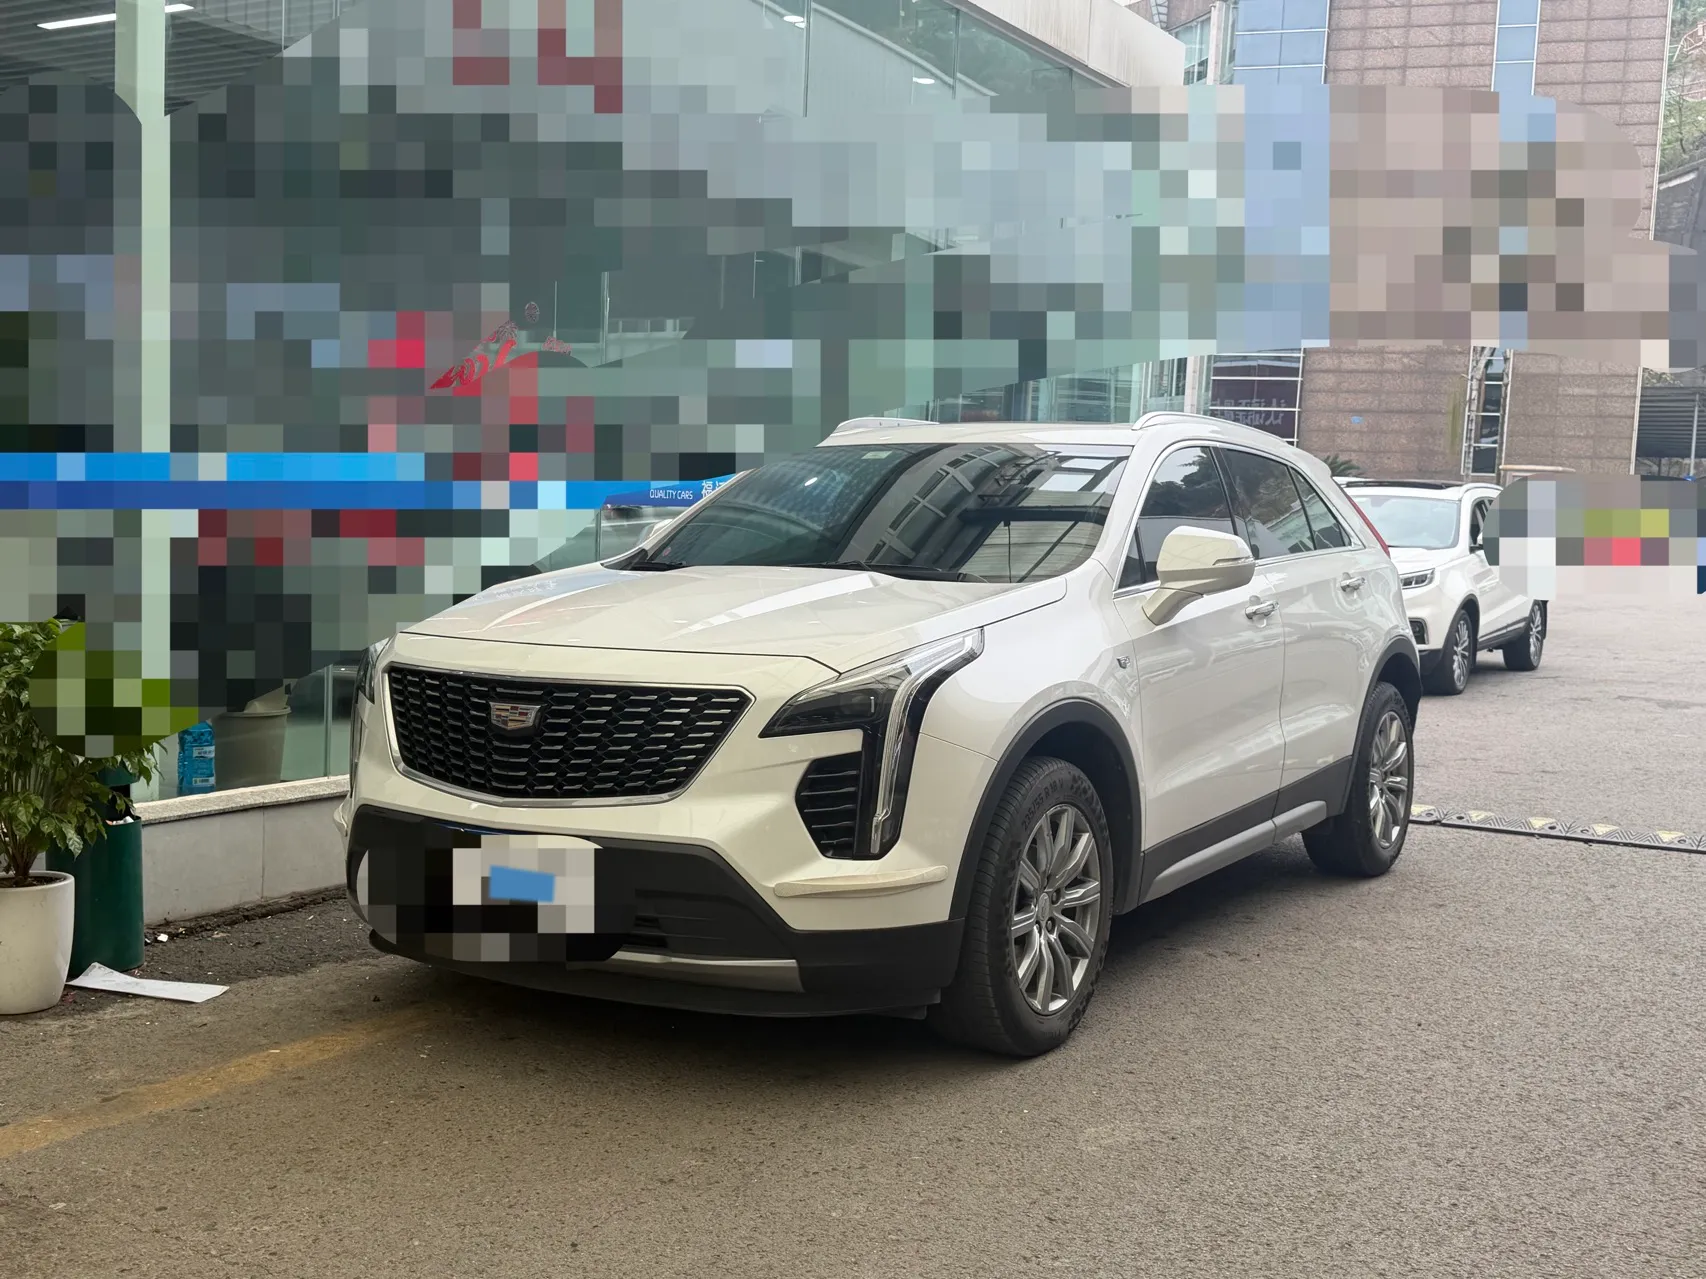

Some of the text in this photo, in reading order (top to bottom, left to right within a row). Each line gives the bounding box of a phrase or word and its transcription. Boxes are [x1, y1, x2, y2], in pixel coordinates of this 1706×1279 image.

[649, 489, 693, 500] QUALITY CARS
[1021, 792, 1044, 832] 235/55
